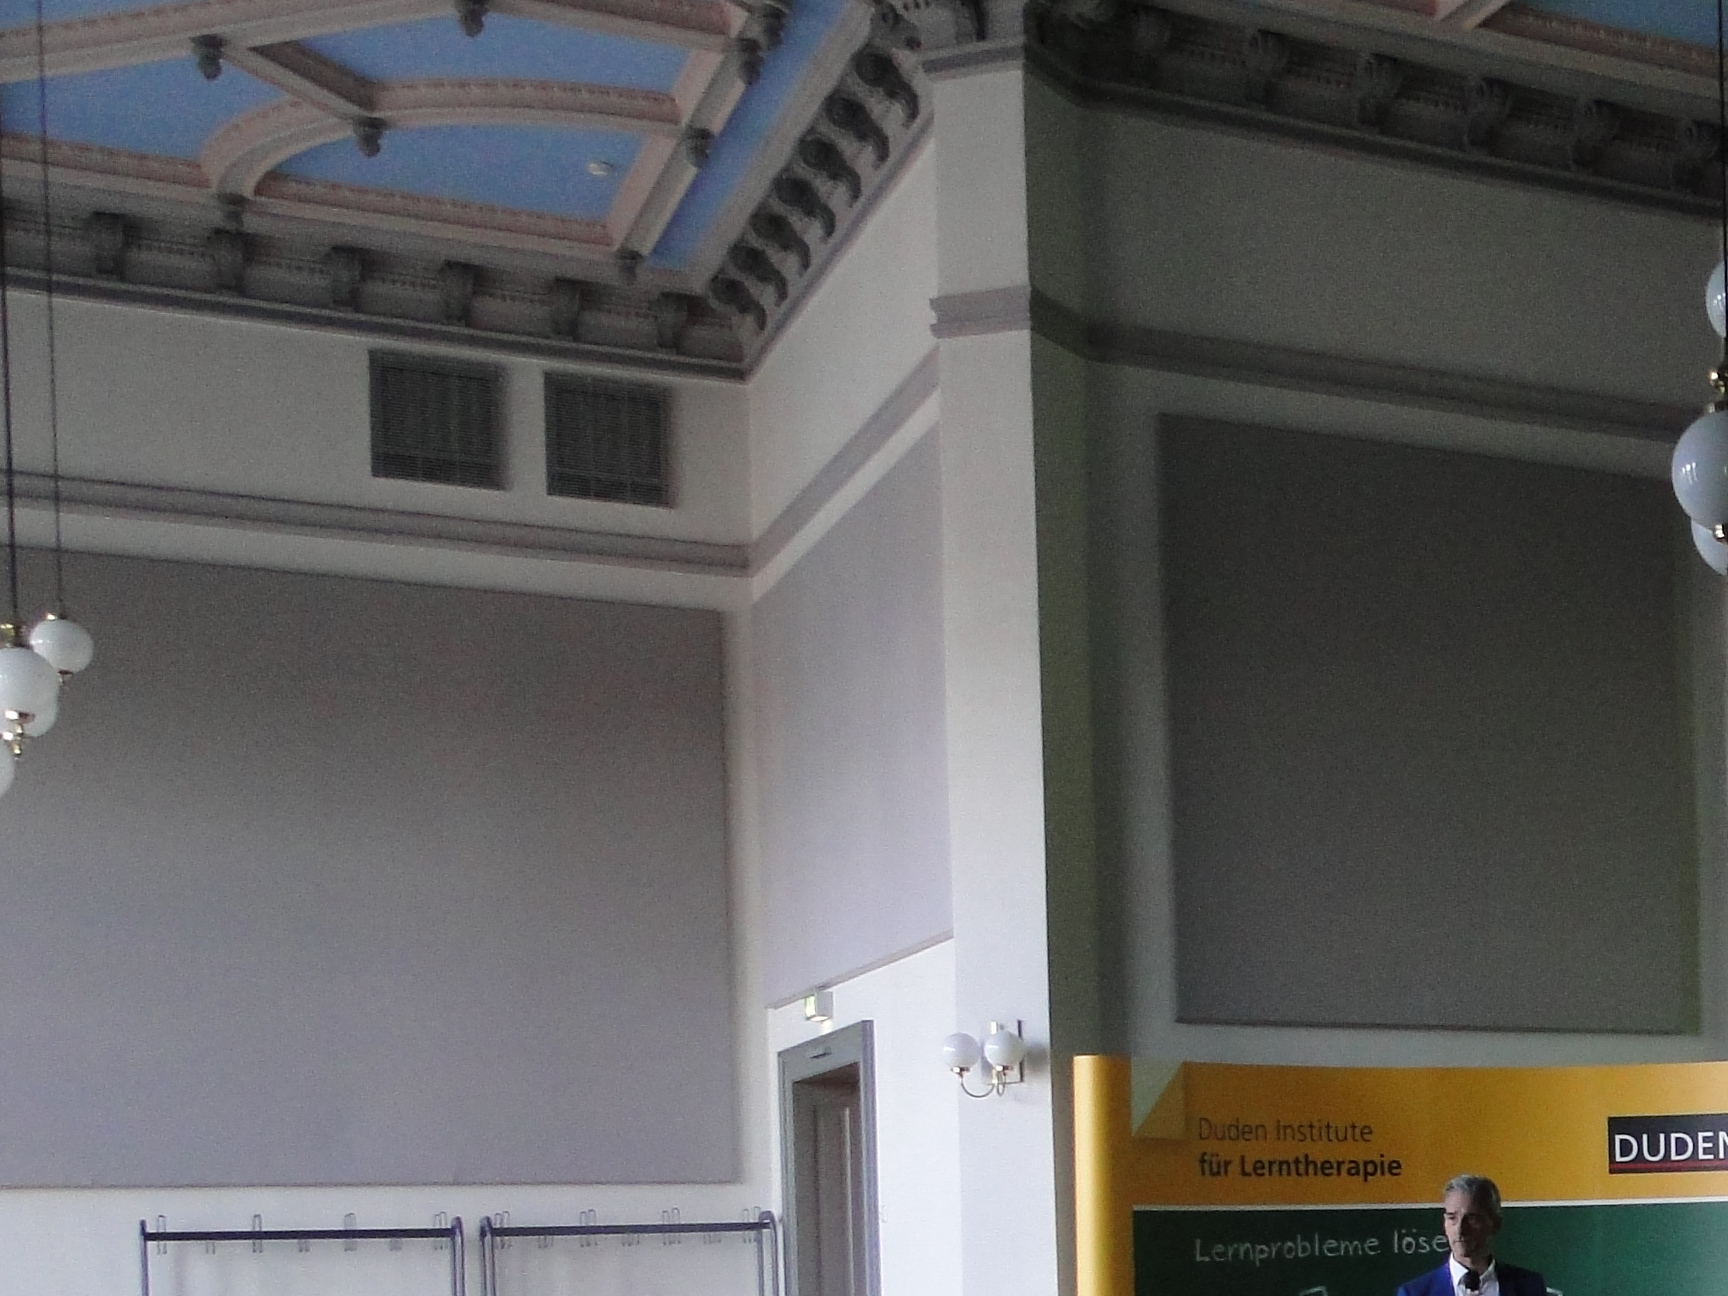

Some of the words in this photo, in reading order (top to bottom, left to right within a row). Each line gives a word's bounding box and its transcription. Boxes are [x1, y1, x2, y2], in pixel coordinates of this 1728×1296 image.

[1199, 1117, 1268, 1142] Duden
[1276, 1119, 1374, 1143] Institute
[1198, 1151, 1232, 1177] für
[1240, 1153, 1403, 1182] Lerntherapie
[1195, 1231, 1381, 1268] Lernprobleme
[1394, 1228, 1450, 1254] löse
